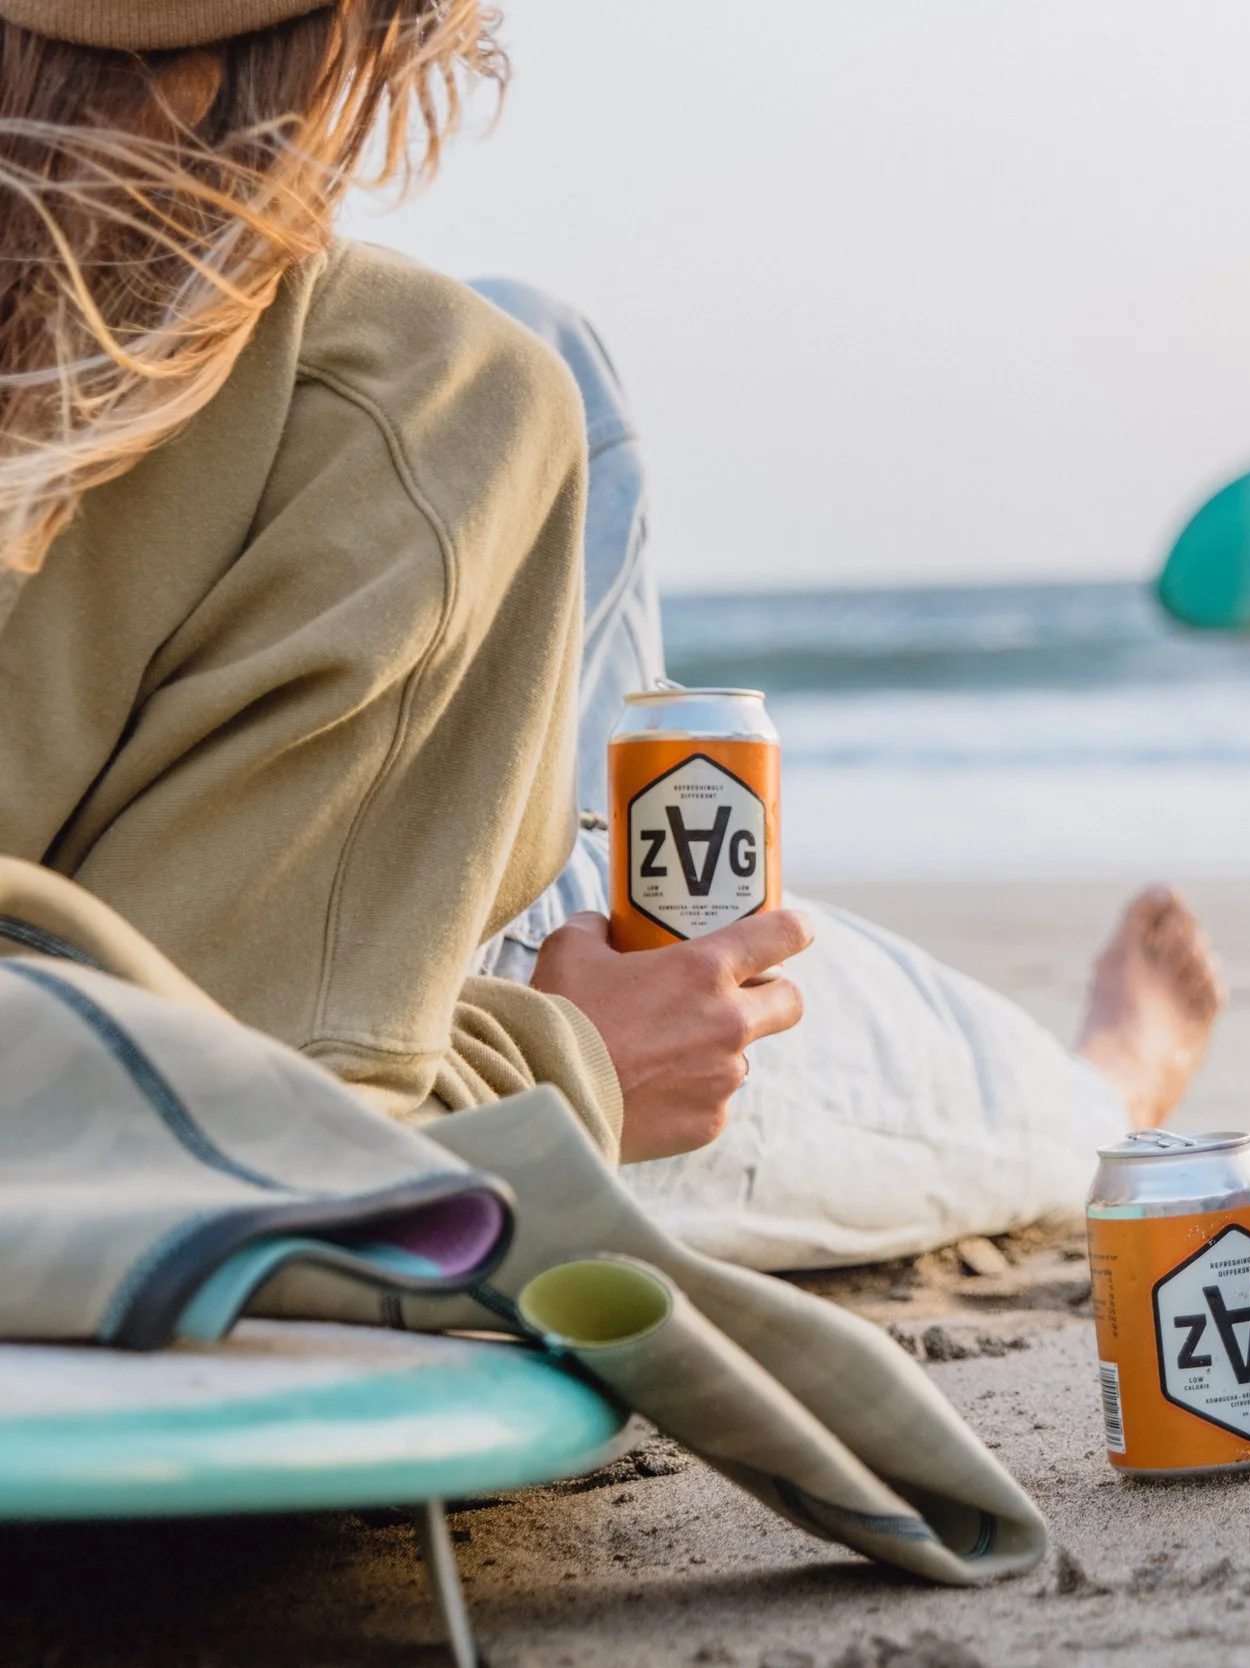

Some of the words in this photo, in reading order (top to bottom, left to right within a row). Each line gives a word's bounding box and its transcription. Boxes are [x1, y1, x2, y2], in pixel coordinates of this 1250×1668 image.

[640, 805, 757, 897] ZAG
[1184, 1383, 1210, 1391] CALORIE
[1205, 1395, 1238, 1404] KOMBUCHA
[1231, 1399, 1250, 1408] CITRUS
